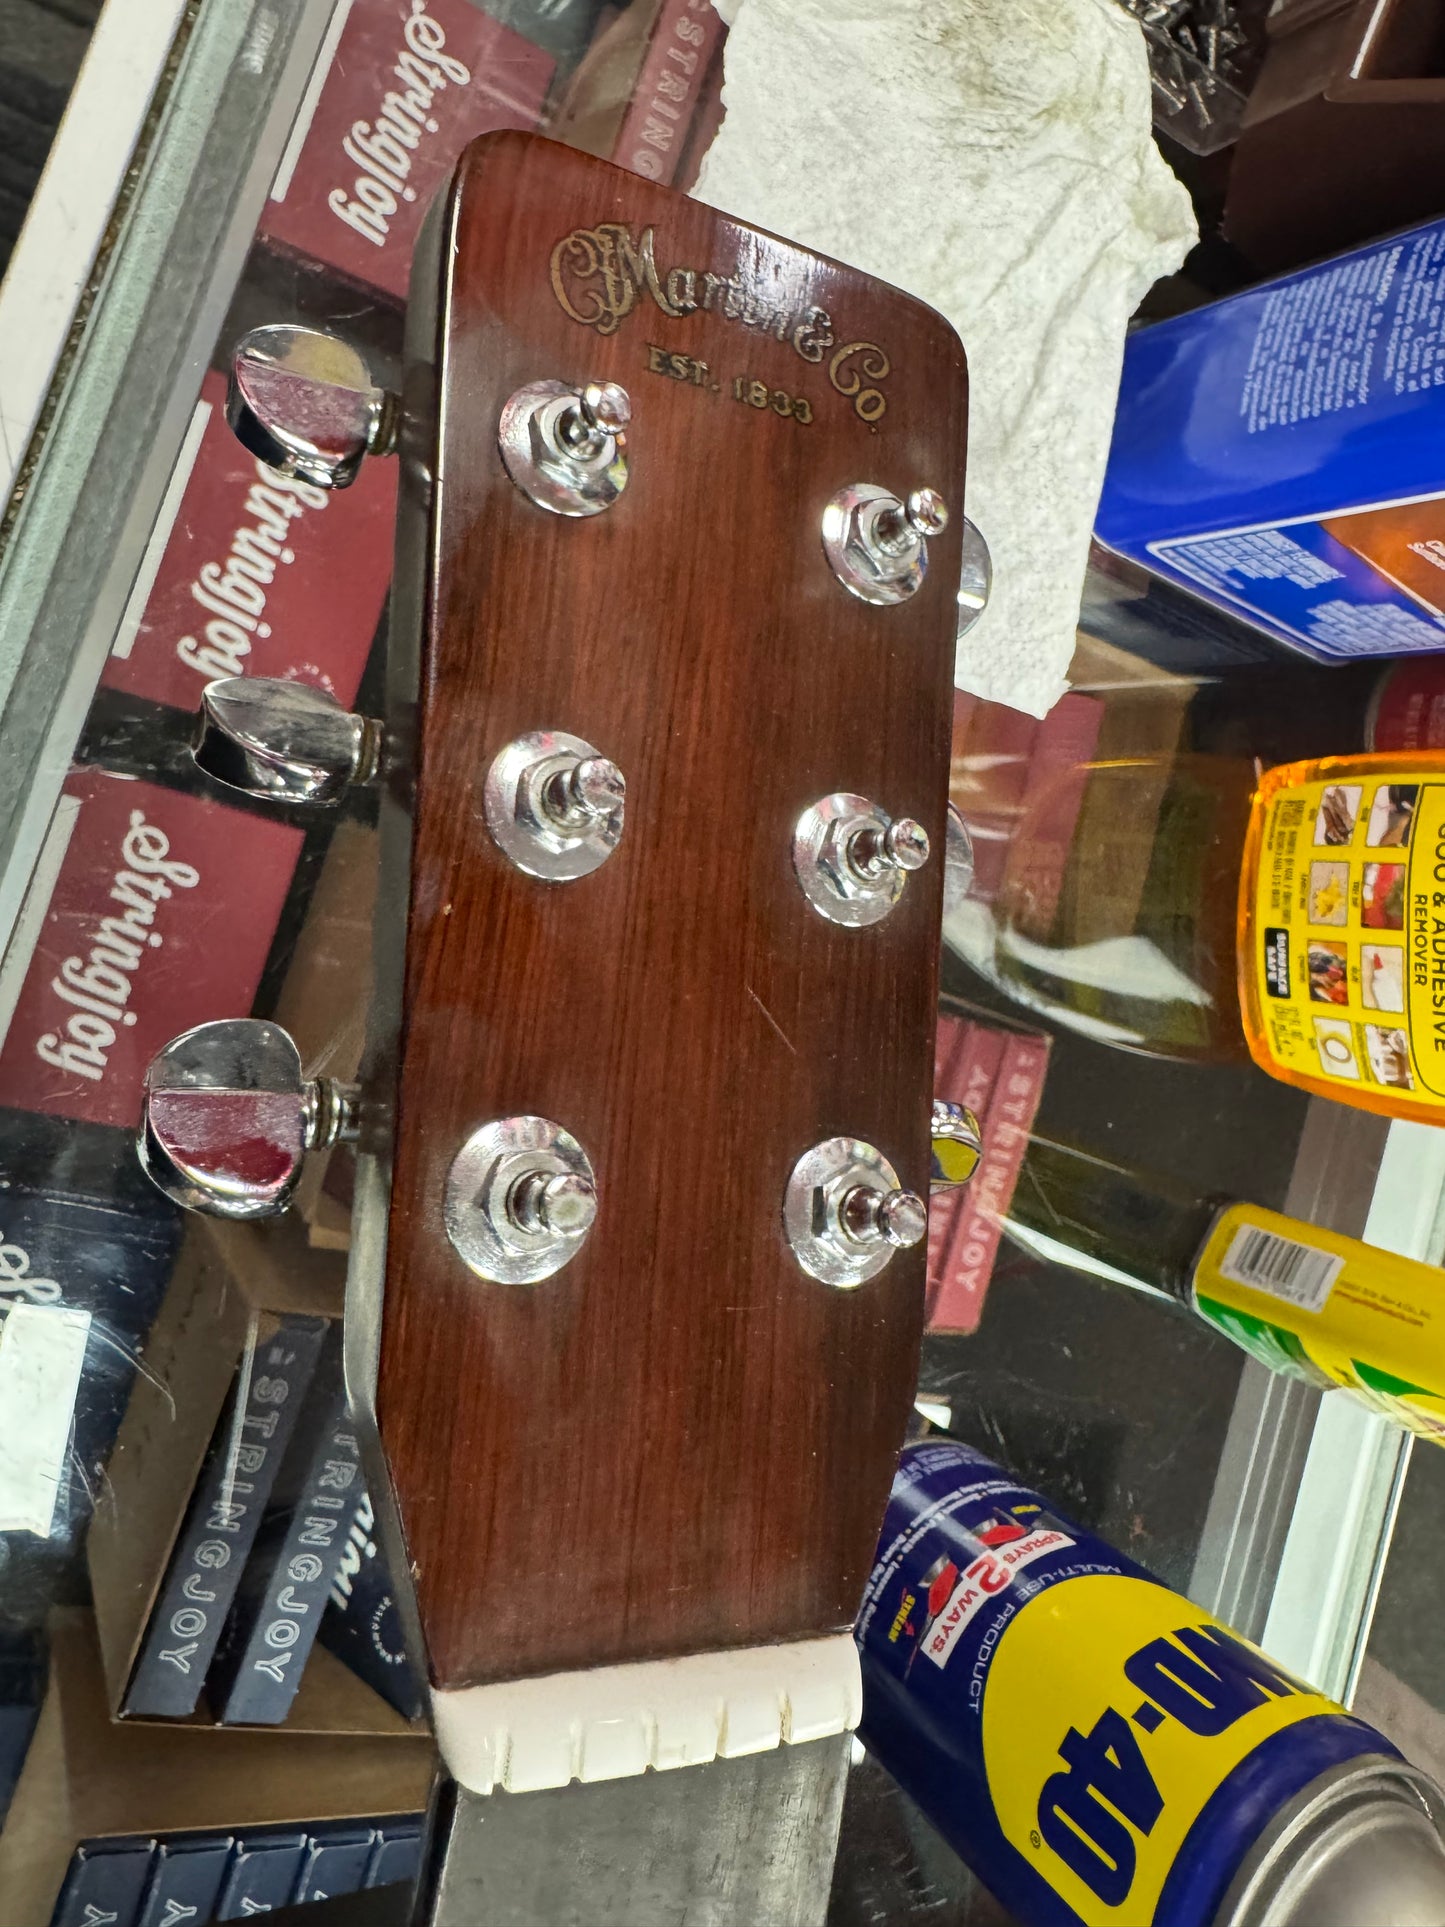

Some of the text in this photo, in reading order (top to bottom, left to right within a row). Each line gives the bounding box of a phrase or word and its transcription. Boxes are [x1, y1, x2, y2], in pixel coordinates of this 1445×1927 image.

[328, 0, 470, 247] Stringjoy
[37, 809, 200, 1080] Stringjoy
[1414, 894, 1428, 987] REMOVER
[1431, 917, 1445, 1053] ADHESIVE
[158, 1375, 290, 1675] STRINGJOY
[254, 1404, 360, 1684] TRINGJOY
[966, 1554, 1010, 1594] 2
[1002, 1531, 1064, 1564] SPRAYS
[1015, 1563, 1122, 1601] MULTI-USE
[968, 1602, 1017, 1715] PRODUCT
